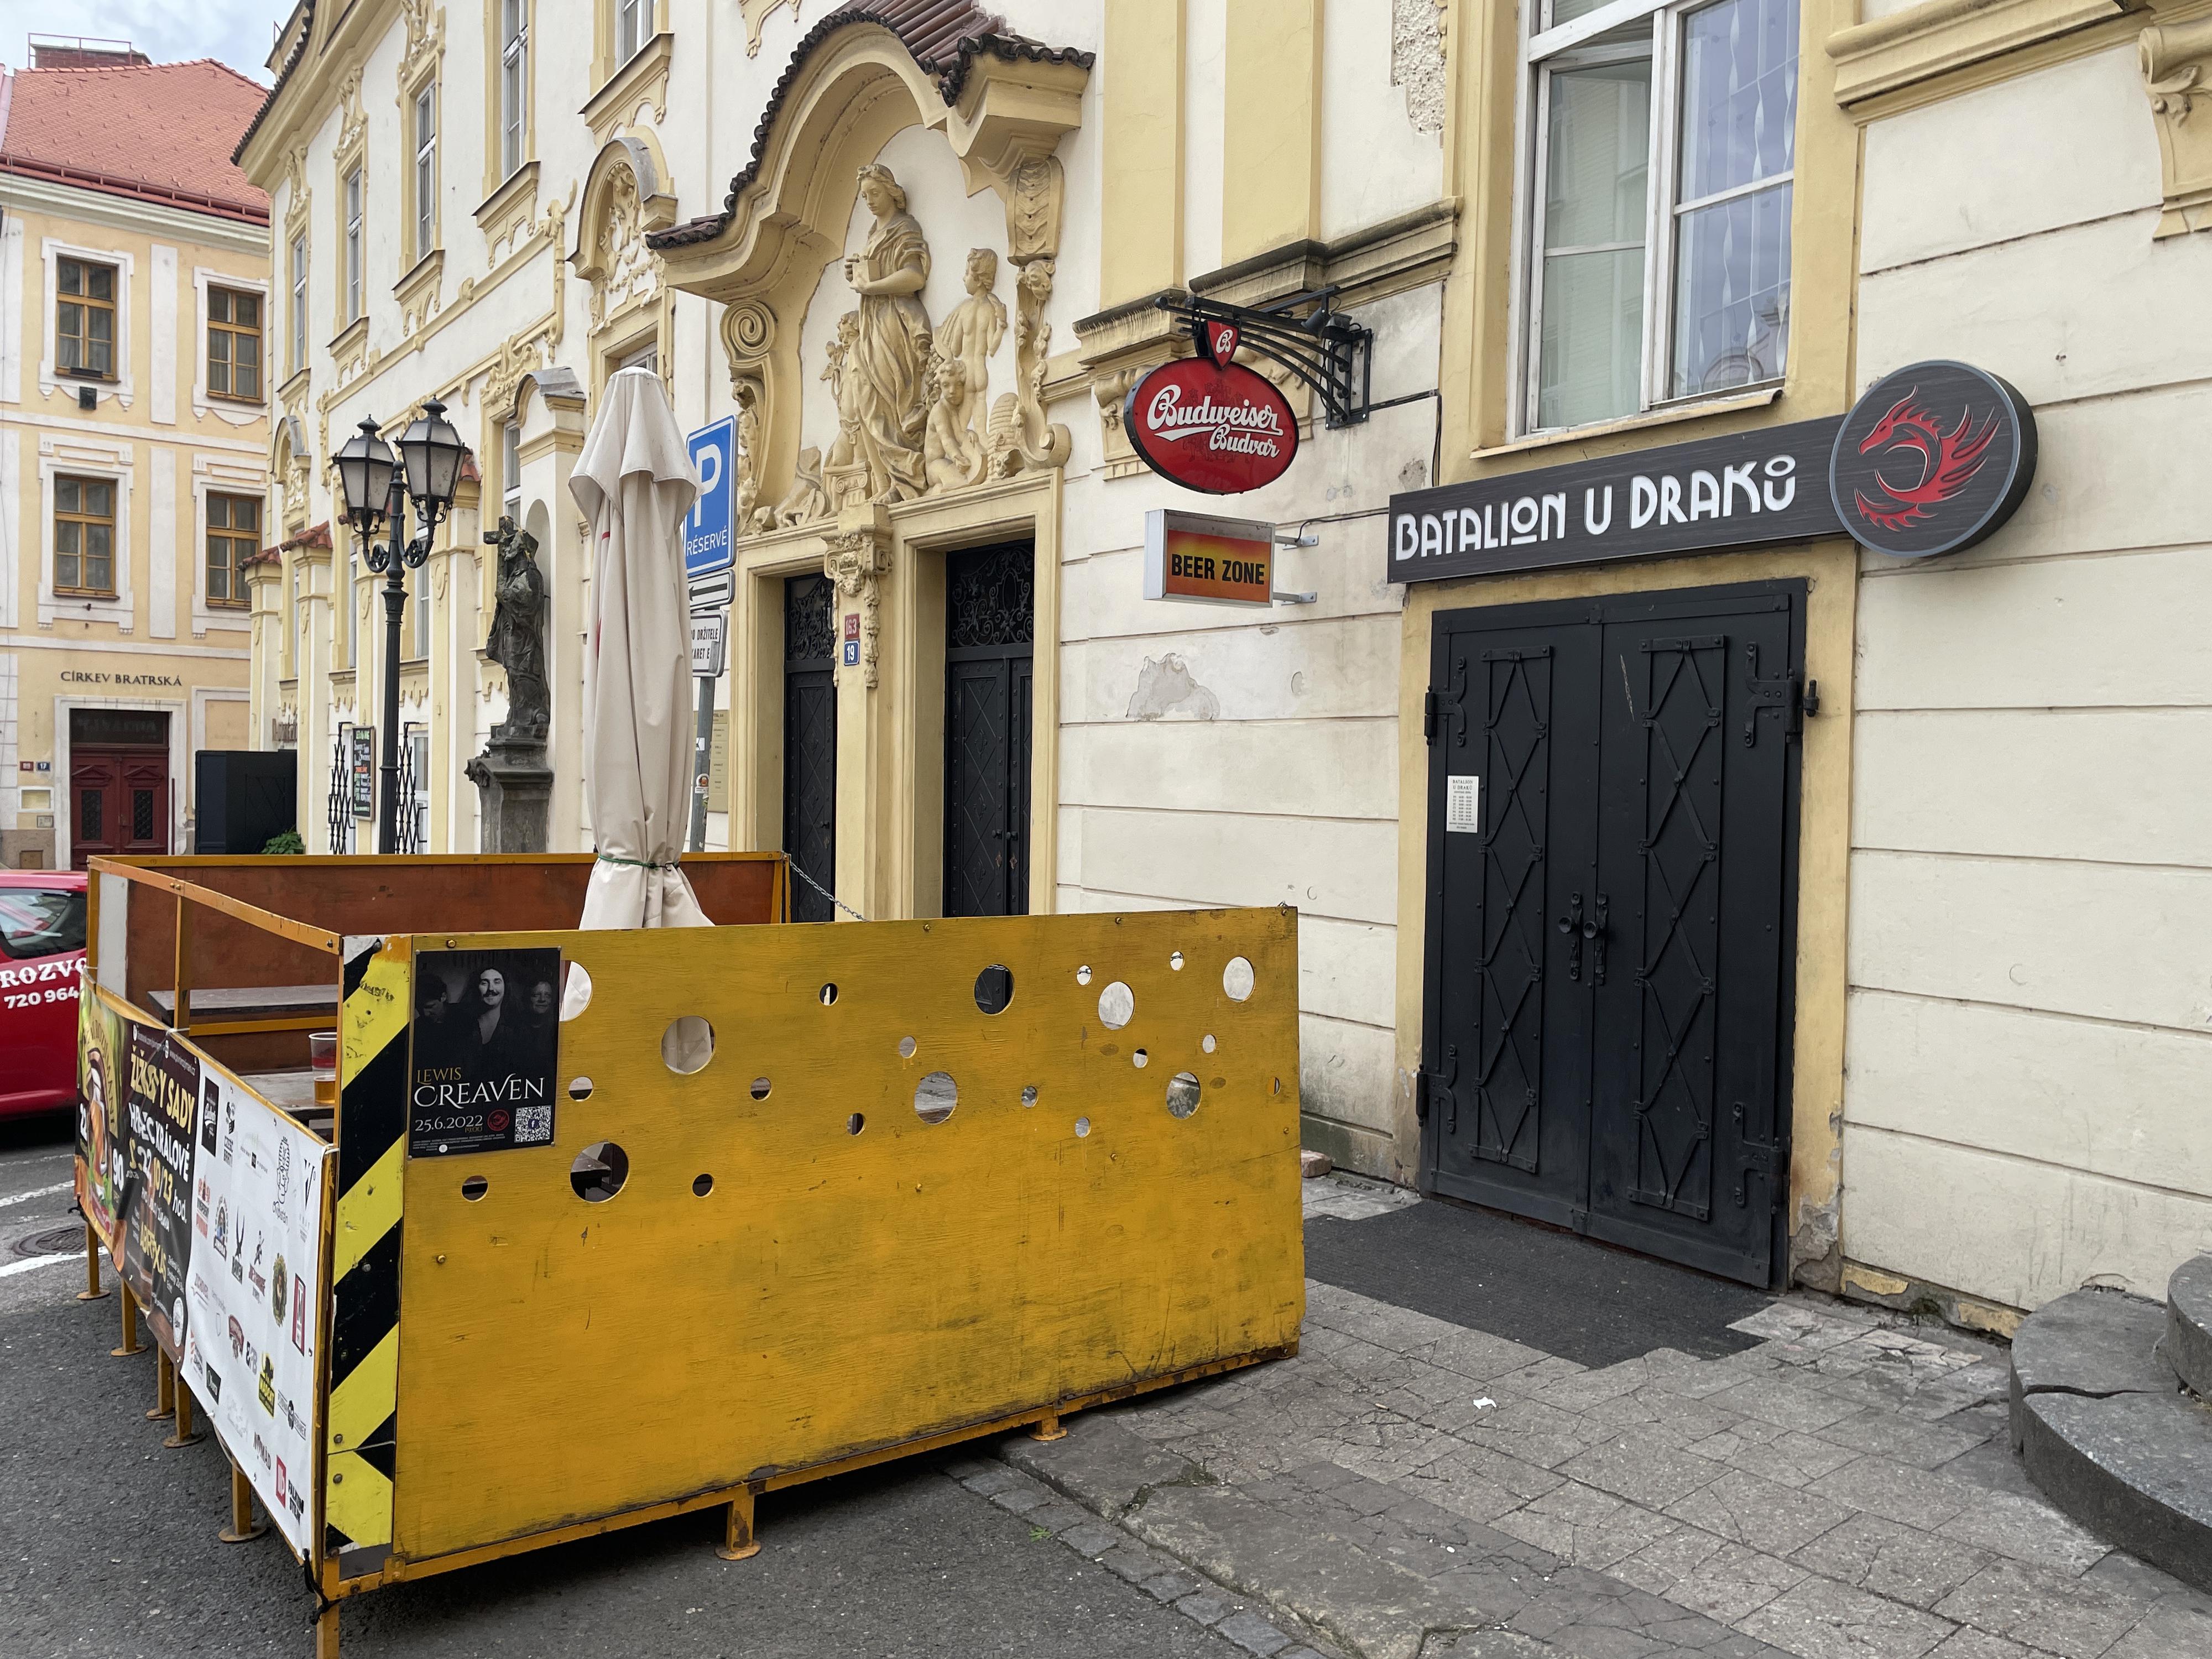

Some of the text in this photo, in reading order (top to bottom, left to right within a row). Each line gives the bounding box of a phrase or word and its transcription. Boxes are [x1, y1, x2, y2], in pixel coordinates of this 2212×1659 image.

[1146, 384, 1284, 436] Budweiser
[1209, 424, 1280, 458] Budvar
[694, 443, 722, 528] P
[1395, 454, 1797, 561] BATALION U DRAKŮ
[686, 525, 728, 557] RÉSERVÉ
[1171, 554, 1265, 585] BEER ZONE
[697, 626, 718, 640] DRŽITELE
[846, 618, 857, 635] 163
[847, 645, 854, 661] 19
[60, 670, 182, 686] CÍRKEV BRATRSKÁ
[4, 986, 79, 1009] 720 964
[414, 1073, 544, 1109] CREAVEN
[416, 1067, 462, 1085] LEWIS
[166, 1078, 195, 1134] SADY
[415, 1115, 483, 1133] 25.6.2022
[155, 1121, 190, 1182] KRÁLOVÉ
[112, 1148, 124, 1192] 90
[173, 1189, 187, 1224] hod.
